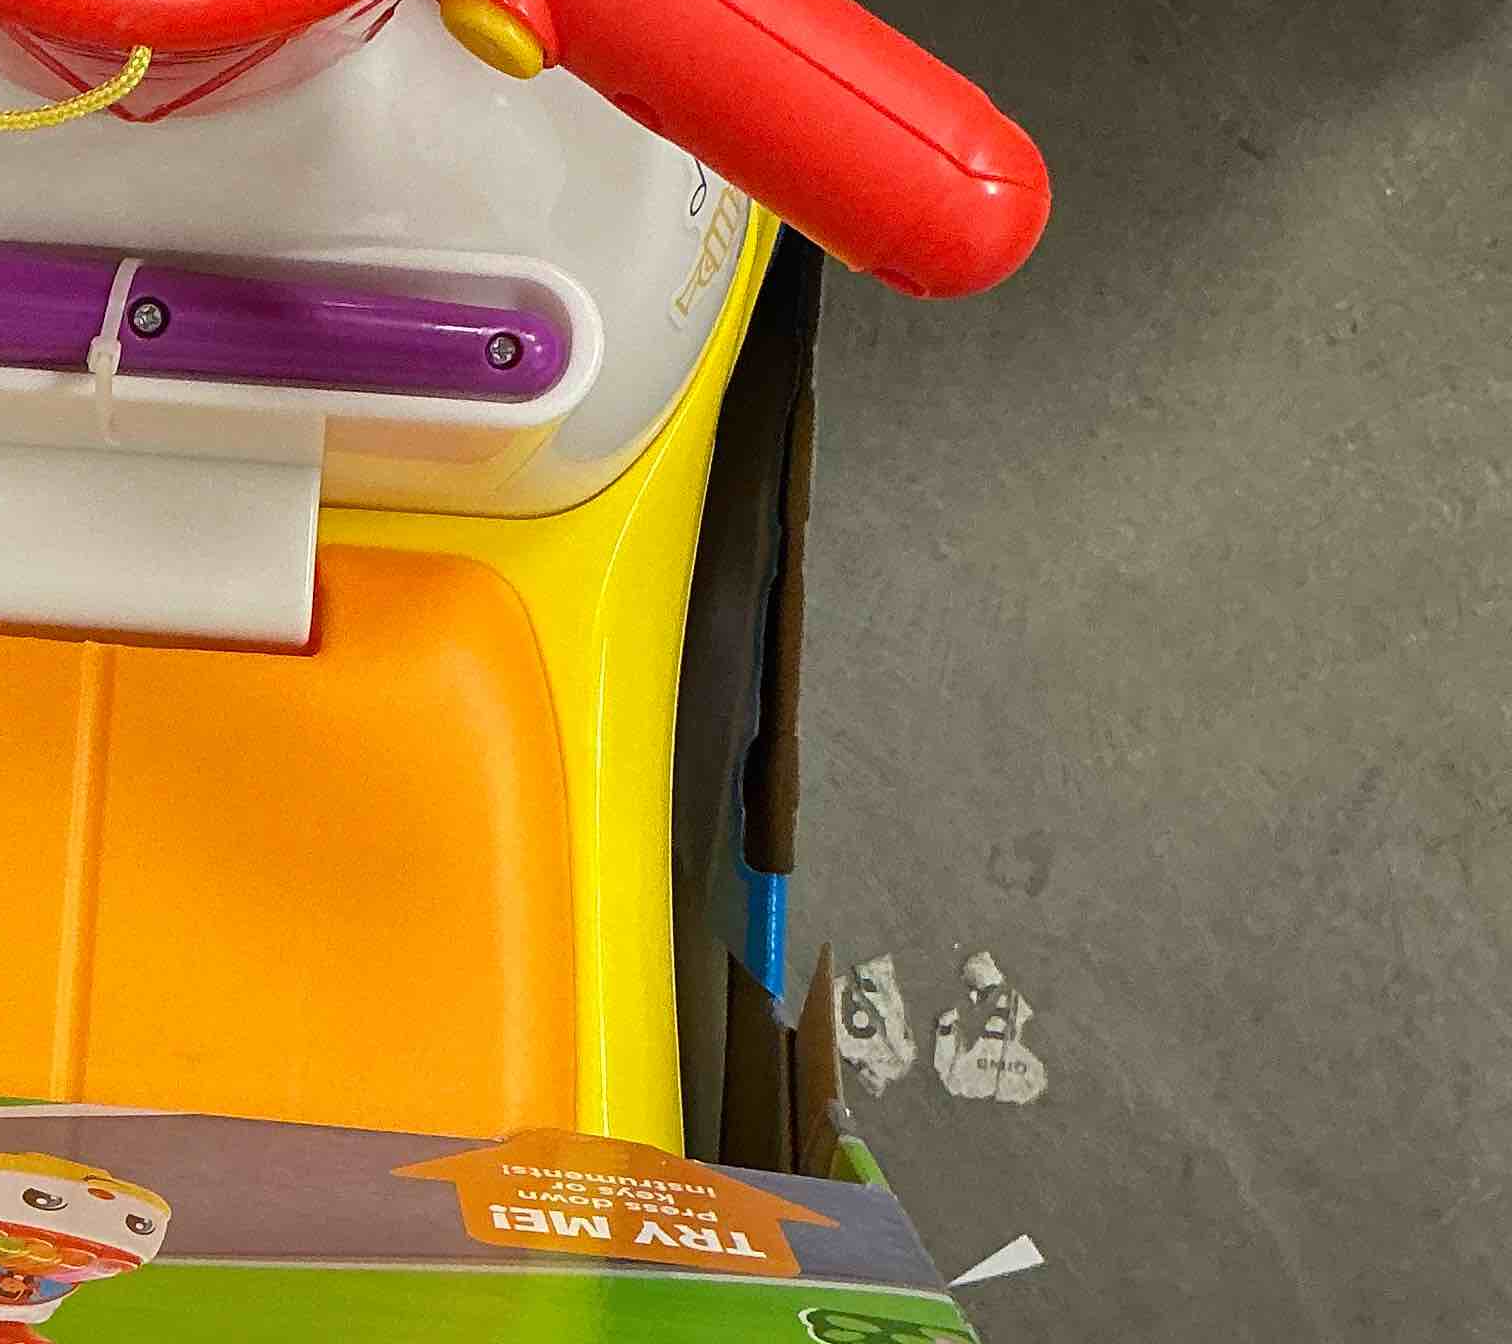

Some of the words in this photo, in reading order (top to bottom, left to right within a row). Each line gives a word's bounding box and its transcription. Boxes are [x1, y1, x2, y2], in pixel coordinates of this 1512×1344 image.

[551, 1181, 587, 1193] or
[517, 1188, 614, 1210] down
[488, 1204, 612, 1241] ME!
[625, 1201, 719, 1223] press
[634, 1219, 768, 1259] TRY
